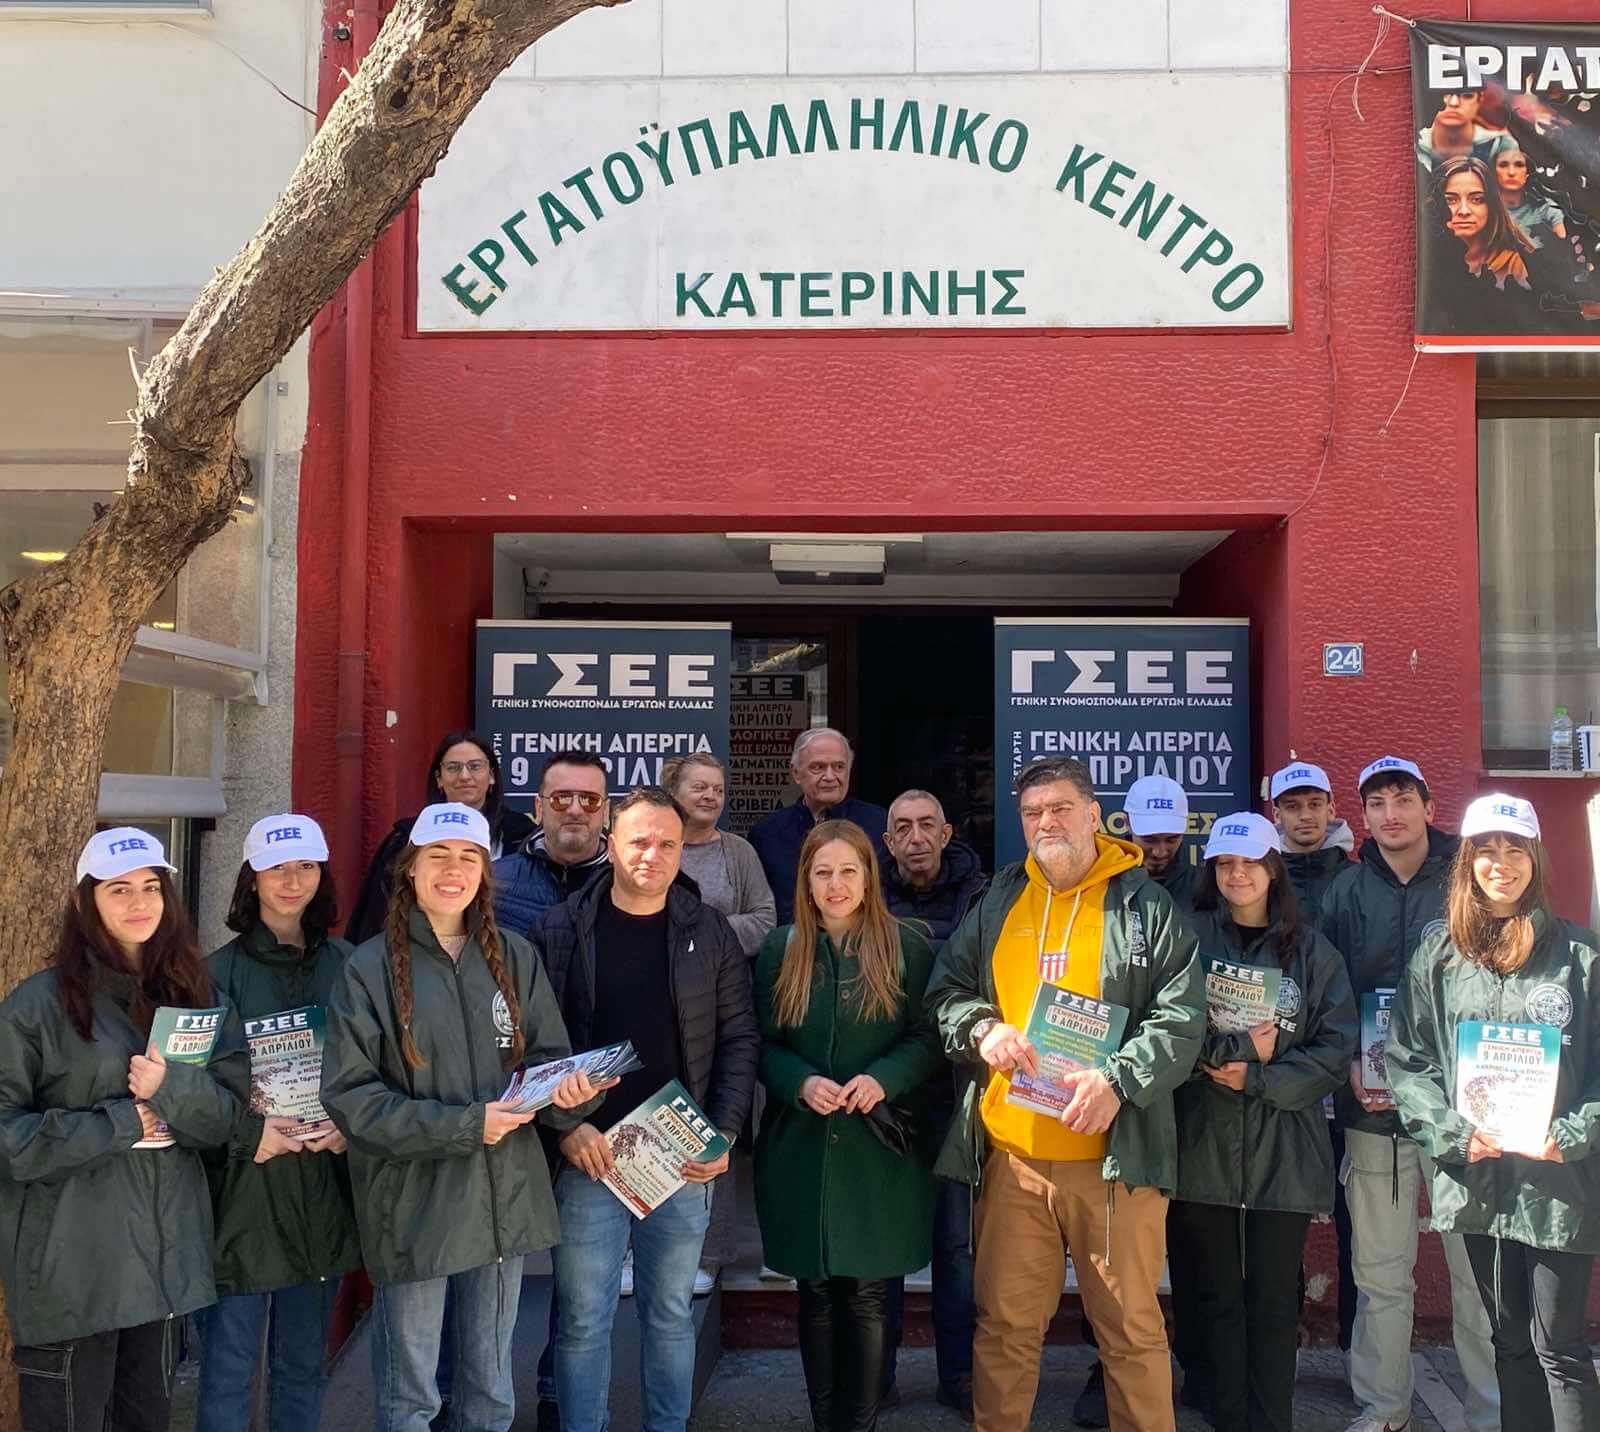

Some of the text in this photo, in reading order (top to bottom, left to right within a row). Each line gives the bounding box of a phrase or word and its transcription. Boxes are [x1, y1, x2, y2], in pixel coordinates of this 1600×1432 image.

[1056, 143, 1265, 313] ΚΕΝΤΡΟ
[675, 270, 1027, 317] ΚΑΤΕΡΙΝΗΣ
[1328, 648, 1360, 670] 24
[493, 653, 715, 697] ΓΣΕΕ
[1011, 650, 1233, 694] ΓΣΕΕ
[492, 699, 714, 710] ΓΕΝΙΚΗ ΣΥΝΟΜΟΣΠΟΝΔΙΑ ΕΡΓΑΤΩΝ ΕΛΛΑΔΑΣ
[1011, 696, 1233, 707] ΓΕΝΙΚΗ ΣΥΝΟΜΟΣΠΟΝΔΙΑ ΕΡΓΑΤΩΝ ΕΛΛΑΔΑΣ
[510, 733, 713, 754] ΓΕΝΙΚΗ ΑΠΕΡΓΙΑ
[1030, 731, 1233, 752] ΓΕΝΙΚΗ ΑΠΕΡΓΙΑ
[511, 757, 529, 786] 9
[1078, 755, 1233, 787] ΠΡΙΛΙΟΥ
[1284, 769, 1312, 782] ΓΣΕΕ
[1146, 798, 1174, 810] ΓΣΕΕ
[434, 812, 470, 825] ΓΣΕΕ
[266, 827, 303, 845] ΓΣΕΕ
[1219, 825, 1250, 837] ΓΣΕΕ
[109, 838, 149, 856] ΓΣΕΕ
[1211, 960, 1264, 983] ΓΣΕΕ
[1218, 984, 1263, 1001] ΑΠΡΙΛΙΟΥ
[1055, 989, 1111, 1019] ΓΣΕΕ
[175, 1014, 219, 1029] ΓΣΕΕ
[245, 1012, 308, 1035] ΓΣΕΕ
[1060, 1017, 1106, 1038] ΑΠΡΙΛΙΟΥ
[1482, 1025, 1542, 1042] ΓΣΕΕ
[261, 1039, 311, 1056] ΑΠΡΙΛΙΟΥ
[1493, 1053, 1541, 1065] ΑΠΡΙΛΙΟΥ
[672, 1096, 717, 1142] ΓΣΕΕ
[663, 1121, 699, 1154] ΑΠΡΙΛΙΟΥ
